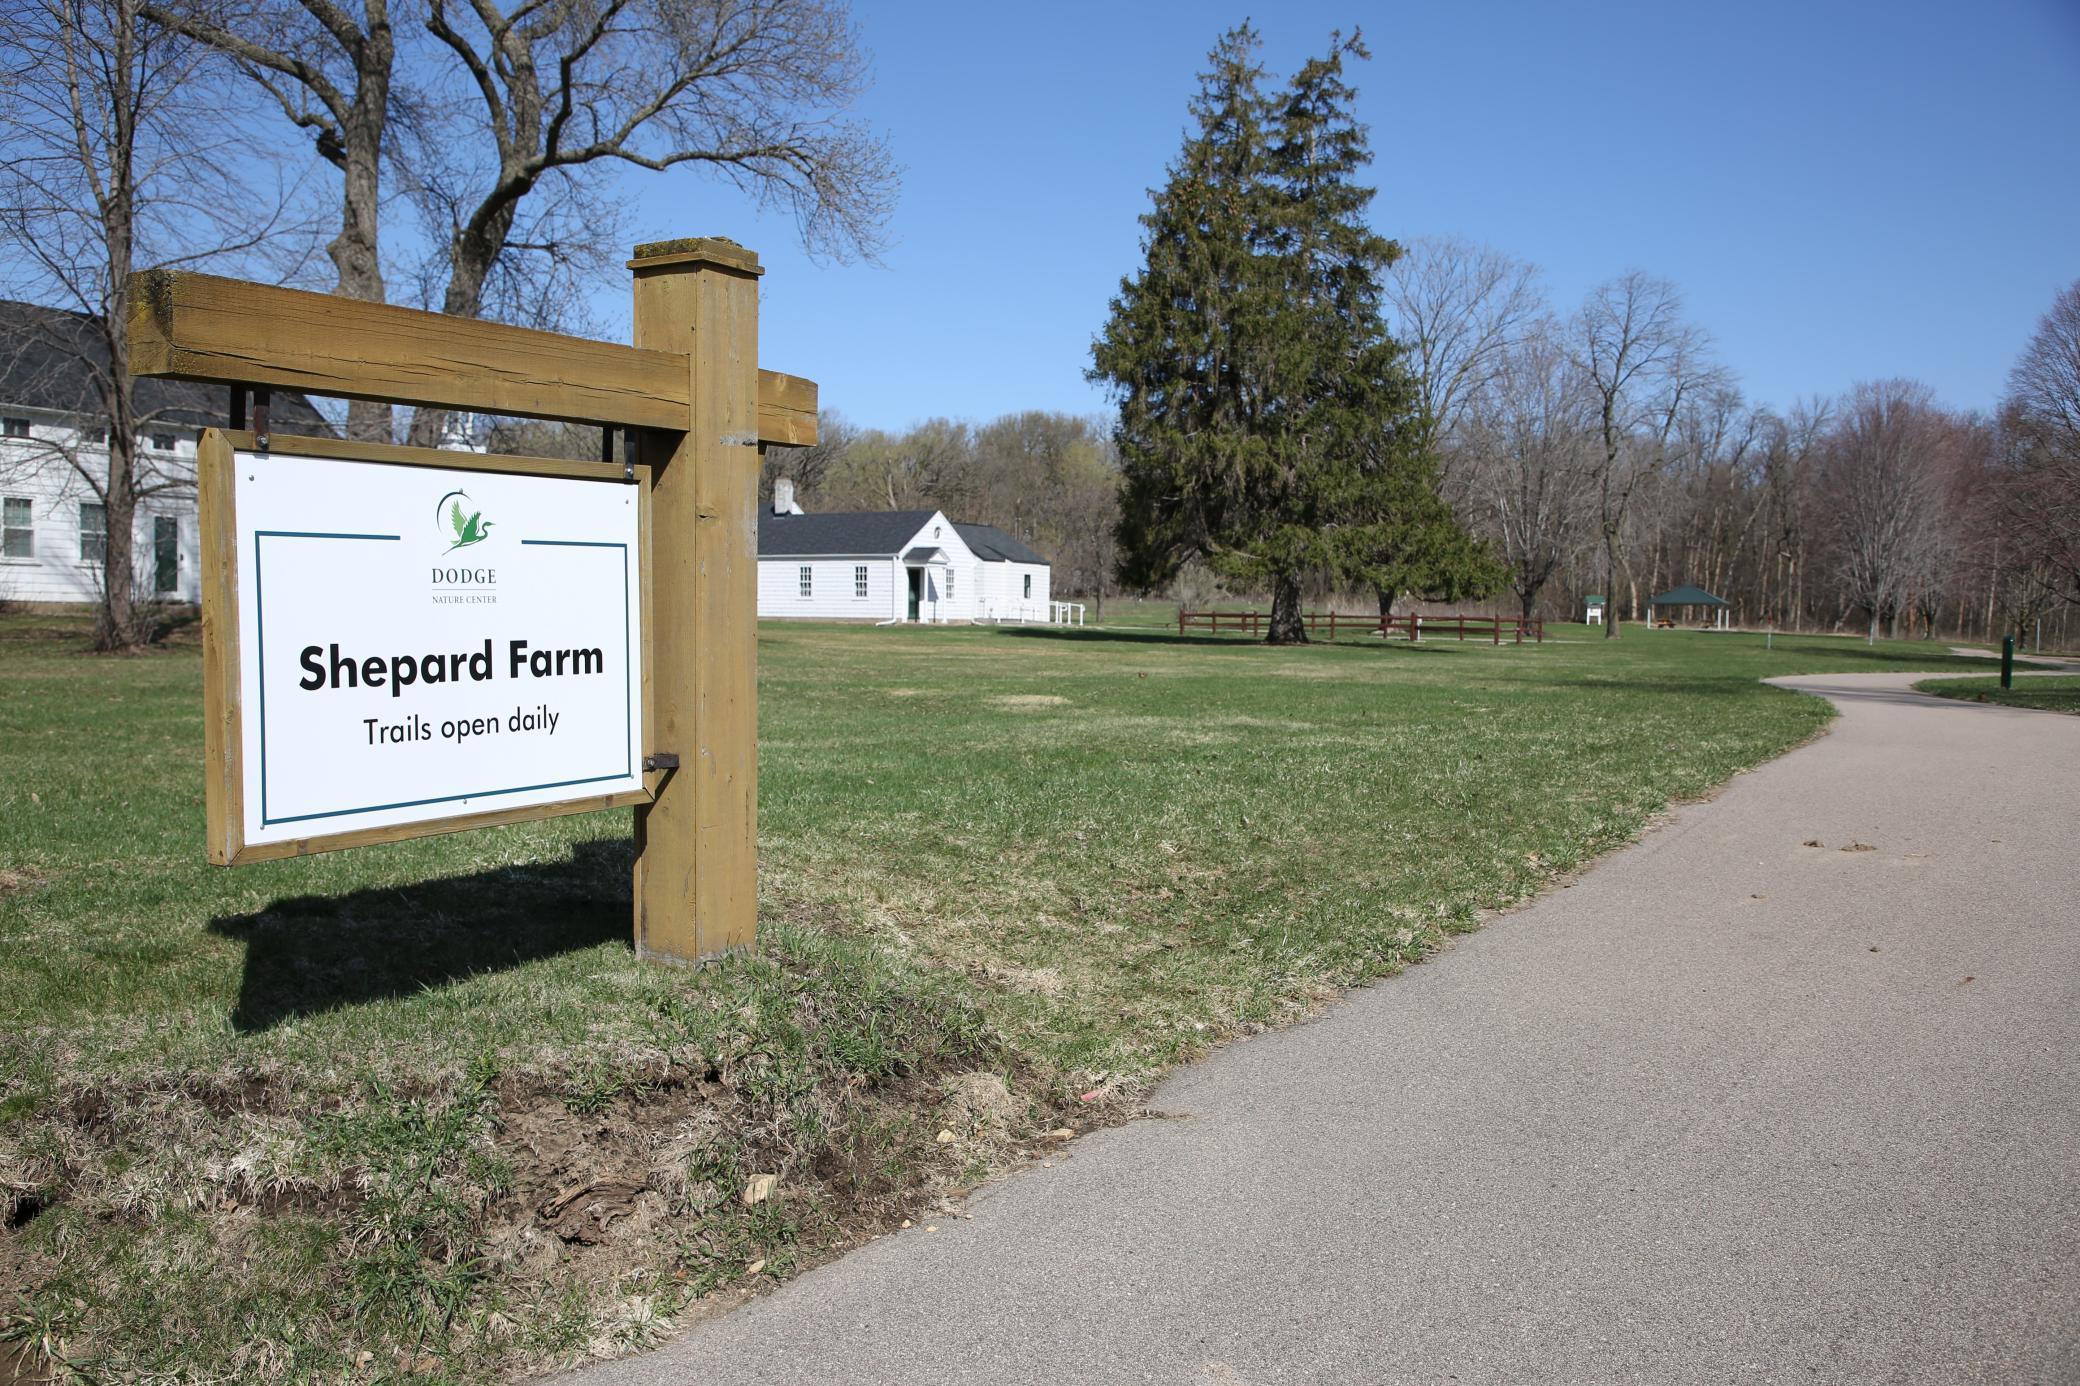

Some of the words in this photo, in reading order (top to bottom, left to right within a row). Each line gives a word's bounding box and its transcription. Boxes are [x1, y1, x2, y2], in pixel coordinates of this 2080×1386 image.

[431, 568, 497, 584] DODGE
[432, 595, 464, 604] NATURE
[466, 595, 497, 604] CENTER
[299, 638, 493, 698] Shepard
[509, 639, 603, 678] Farm
[363, 713, 432, 745] Trails
[440, 714, 500, 744] open
[508, 704, 560, 735] daily
